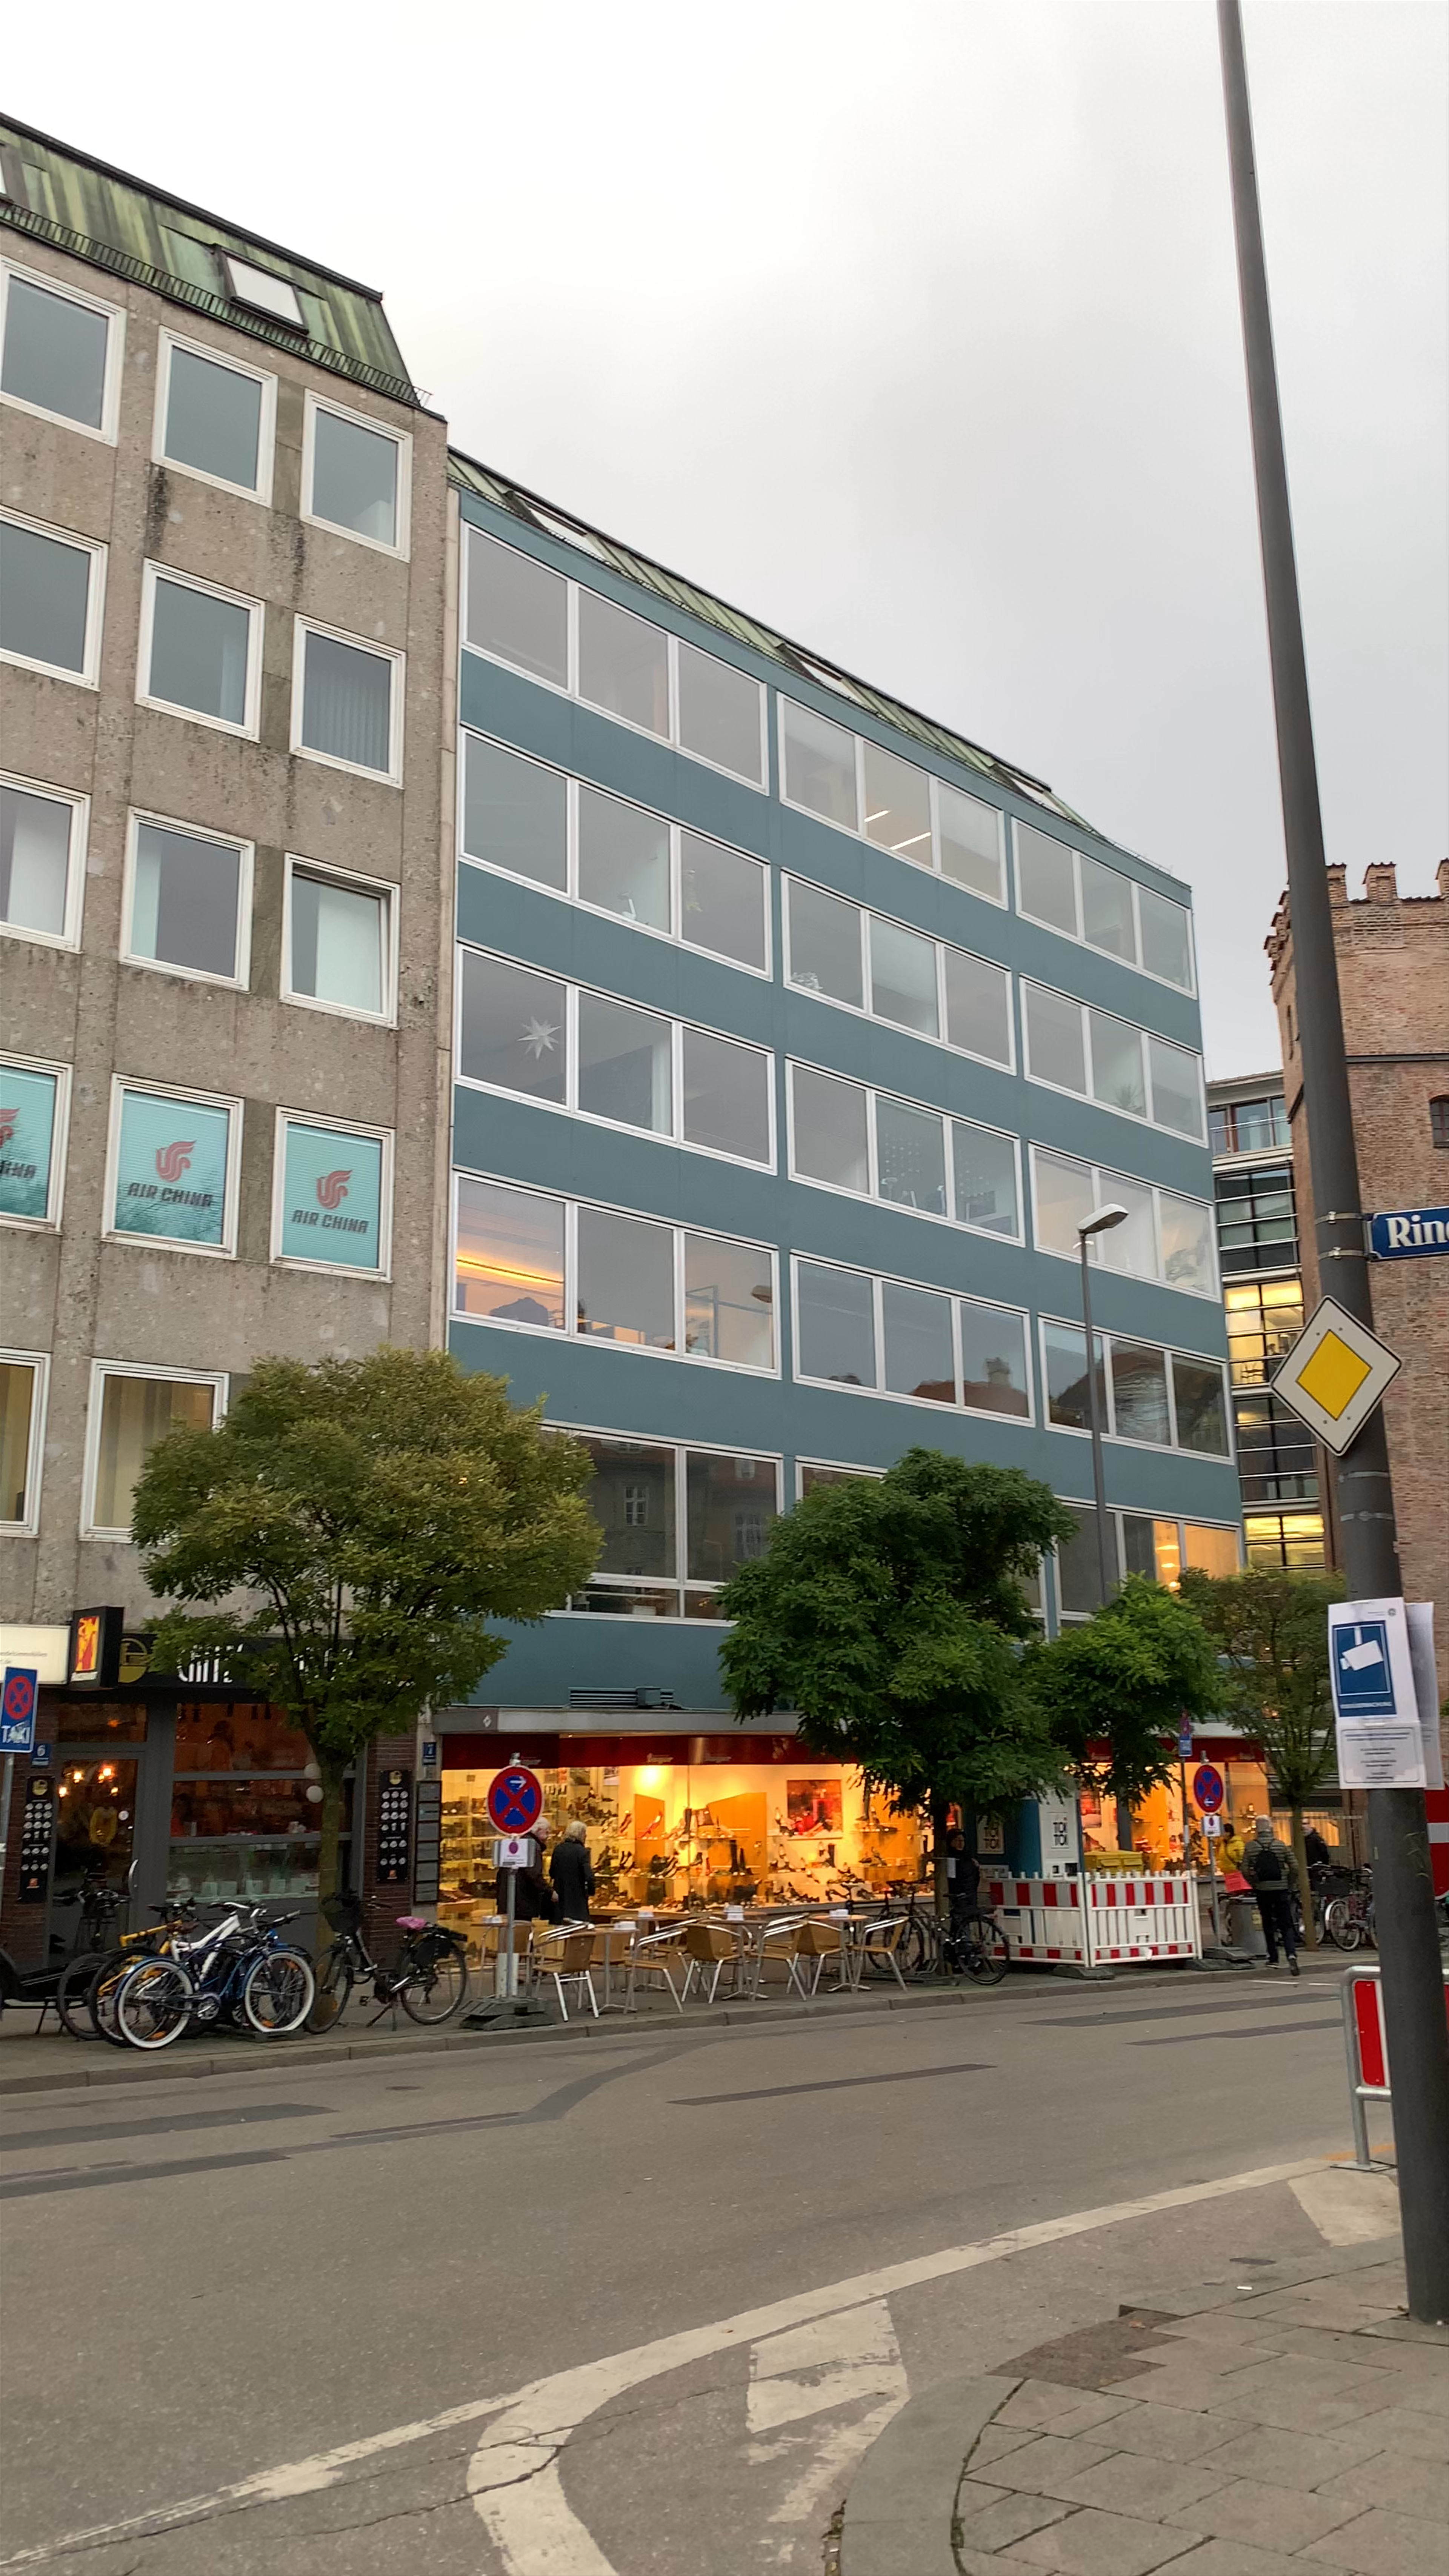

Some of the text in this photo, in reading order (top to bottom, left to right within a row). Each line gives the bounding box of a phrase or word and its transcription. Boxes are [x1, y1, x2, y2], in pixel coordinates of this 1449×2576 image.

[128, 1182, 213, 1207] AIR CHINA
[292, 1209, 369, 1234] AIR CHINA
[1385, 1214, 1449, 1248] Rin
[37, 1745, 45, 1756] 6
